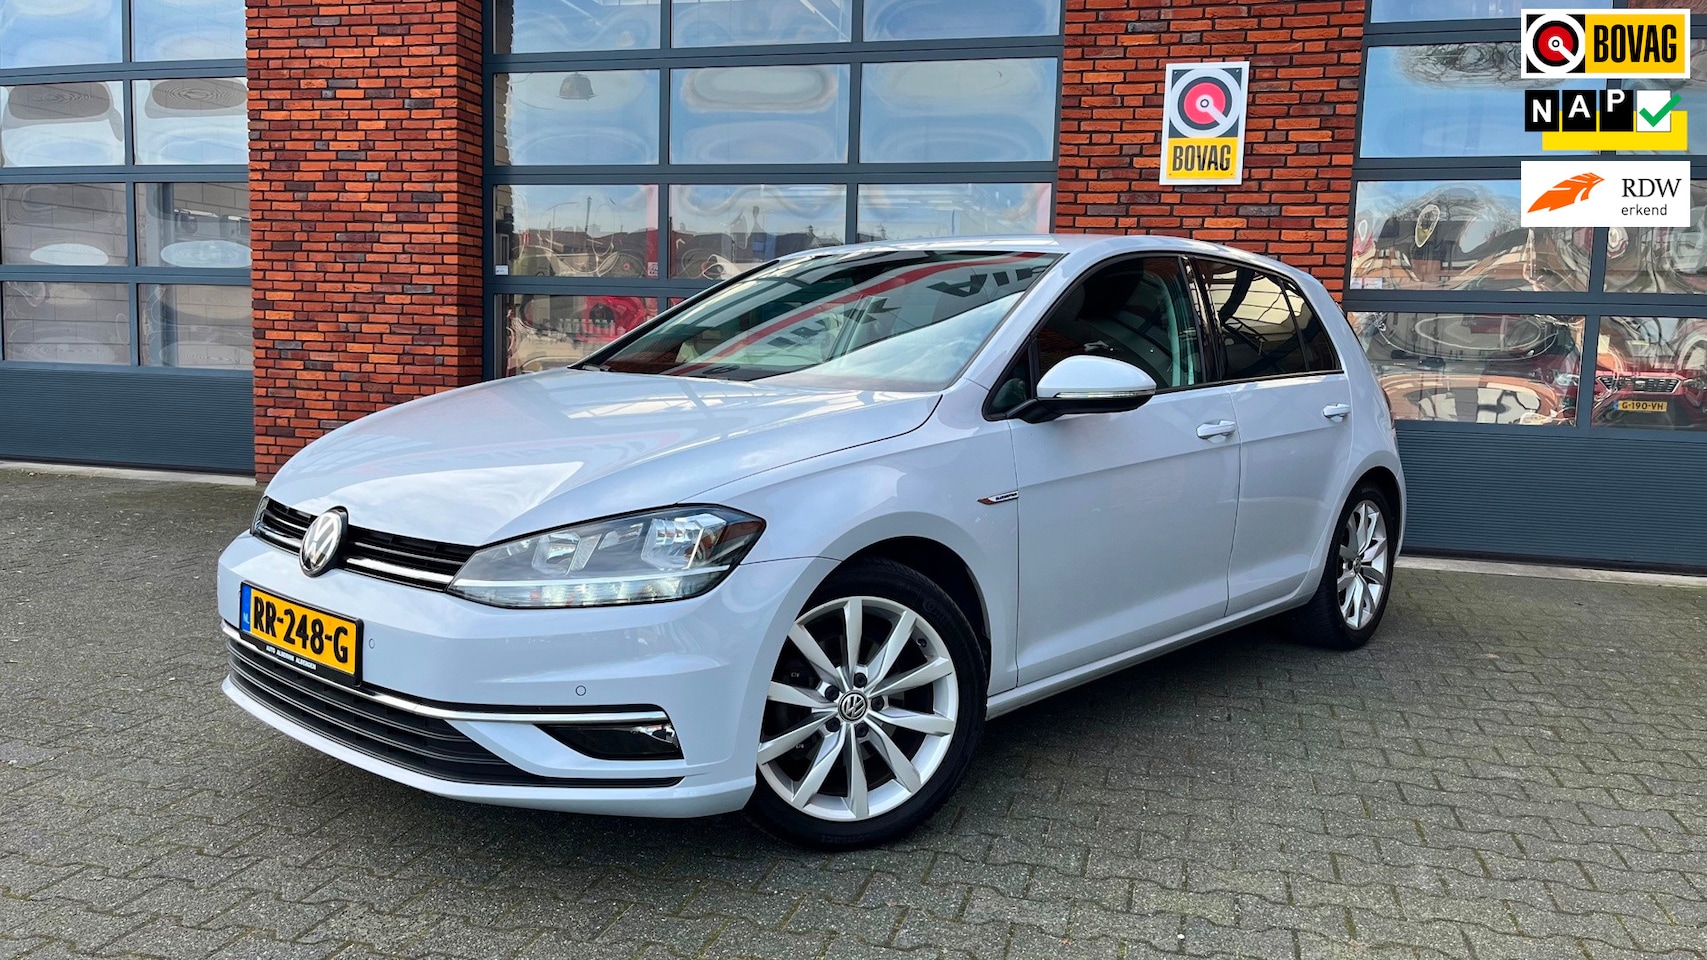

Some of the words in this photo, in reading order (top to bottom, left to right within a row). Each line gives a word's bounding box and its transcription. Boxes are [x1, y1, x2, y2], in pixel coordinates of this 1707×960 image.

[1172, 144, 1231, 172] BOVAG
[1621, 401, 1664, 411] G-190-VH
[253, 595, 349, 664] RR-248-G
